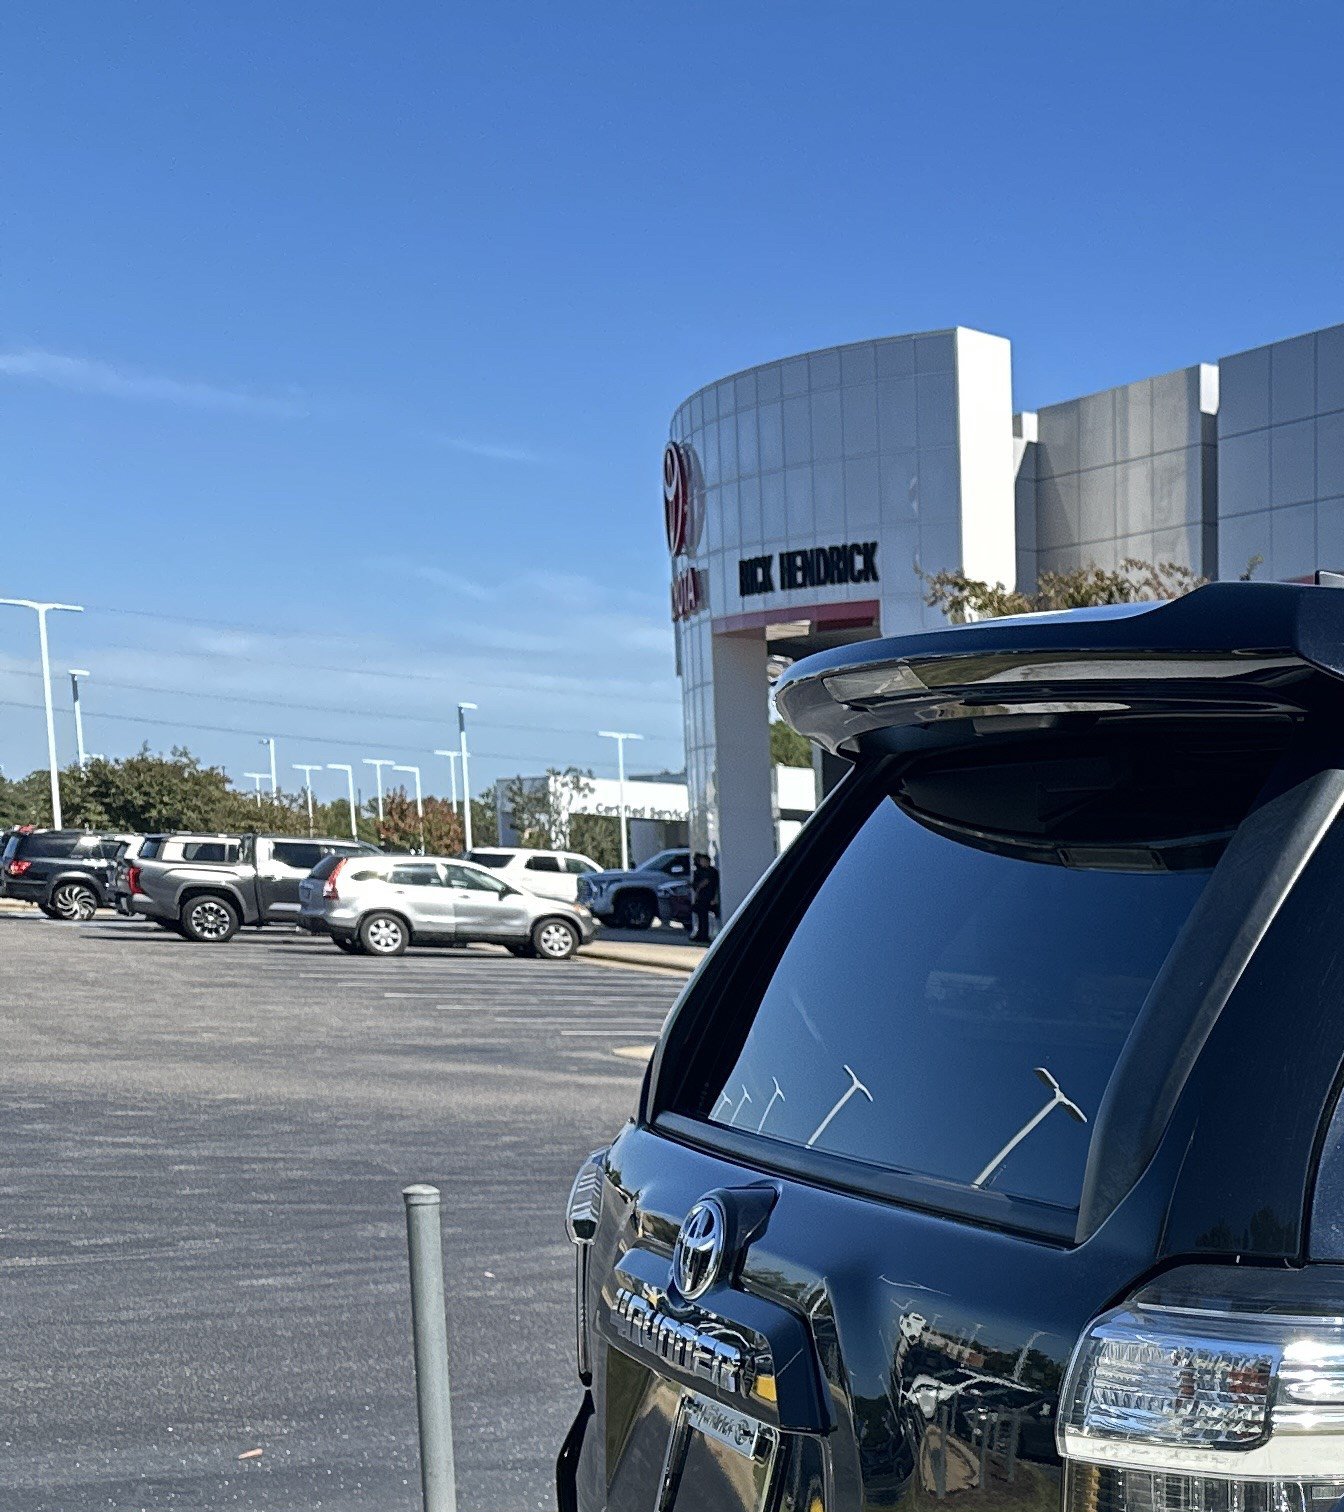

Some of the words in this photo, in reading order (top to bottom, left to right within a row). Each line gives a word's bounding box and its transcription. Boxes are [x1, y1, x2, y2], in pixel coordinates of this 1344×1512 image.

[739, 554, 775, 597] RICK
[779, 541, 879, 591] HENDRICK
[596, 803, 645, 818] Certfied
